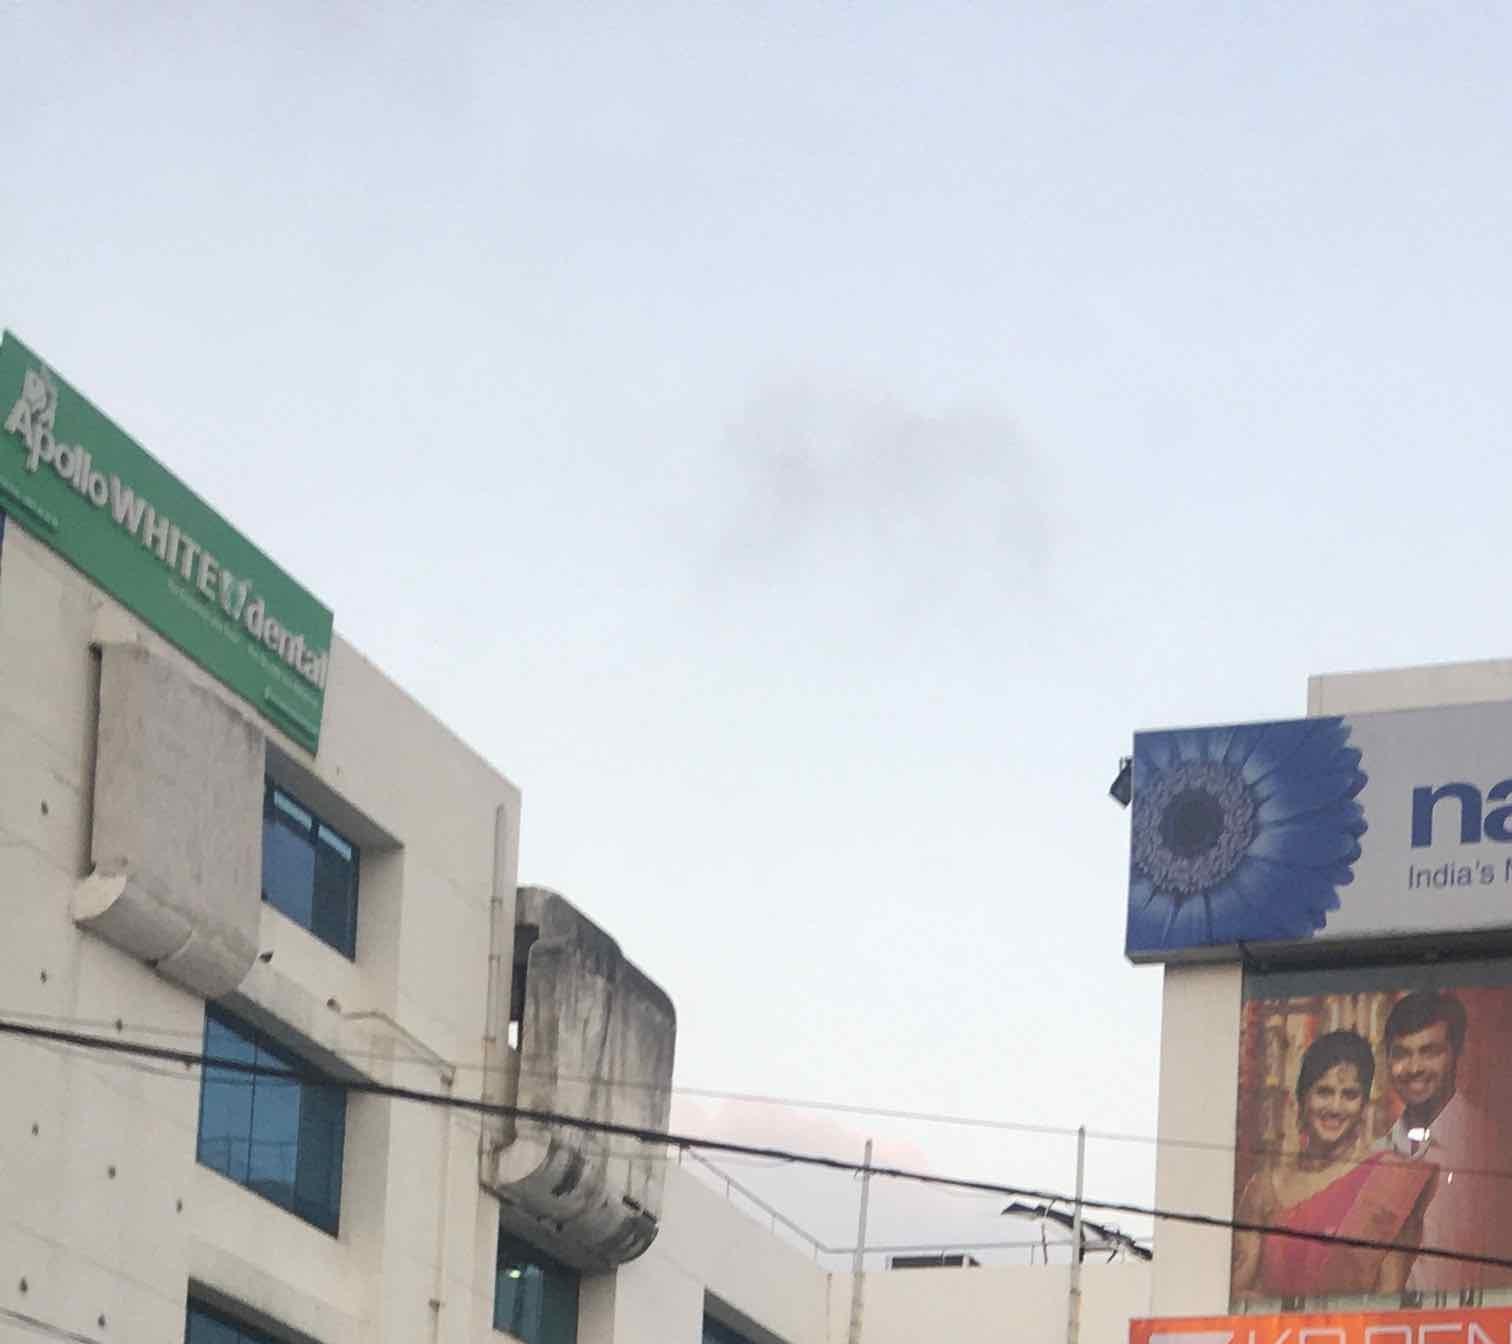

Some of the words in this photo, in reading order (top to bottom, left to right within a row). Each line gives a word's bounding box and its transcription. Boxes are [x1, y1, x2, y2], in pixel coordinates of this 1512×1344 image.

[4, 398, 109, 507] Apollo
[109, 472, 219, 602] WHITE
[1408, 862, 1495, 890] India's
